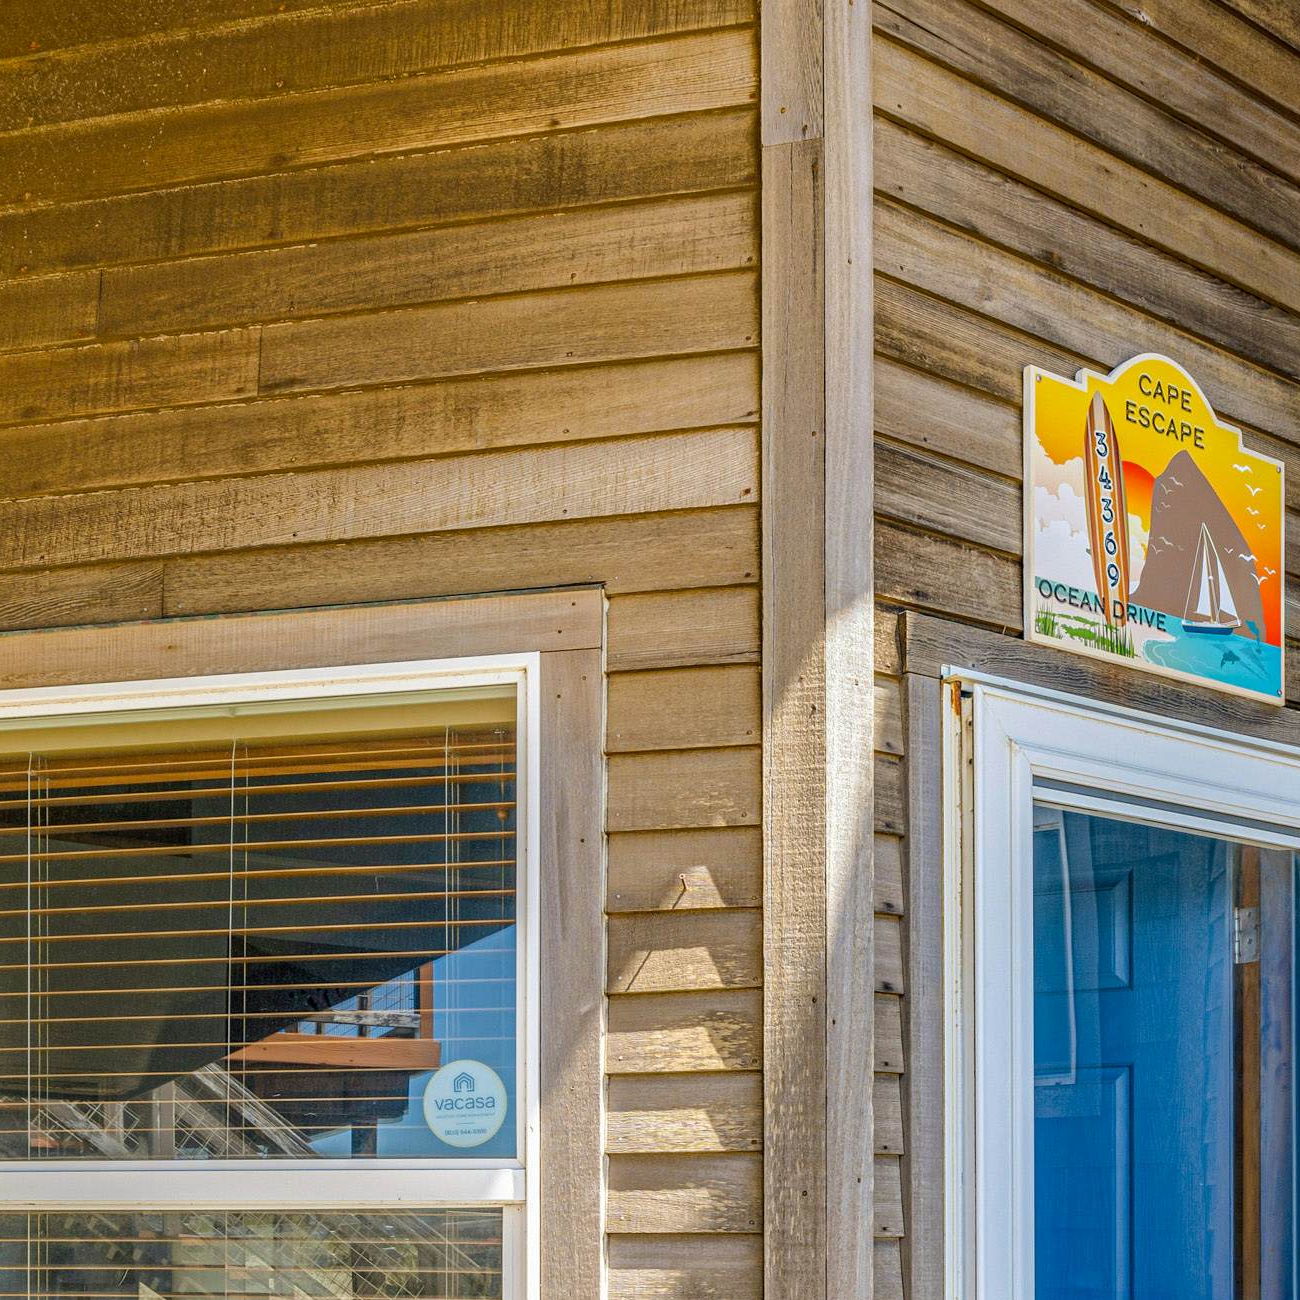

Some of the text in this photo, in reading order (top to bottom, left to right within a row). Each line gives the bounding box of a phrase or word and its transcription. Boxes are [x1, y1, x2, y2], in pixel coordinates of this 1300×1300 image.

[1138, 373, 1193, 413] CAPE
[1125, 401, 1205, 450] ESCAPE
[1038, 579, 1167, 632] OCEAN DRIVE
[434, 1096, 495, 1111] vacasa
